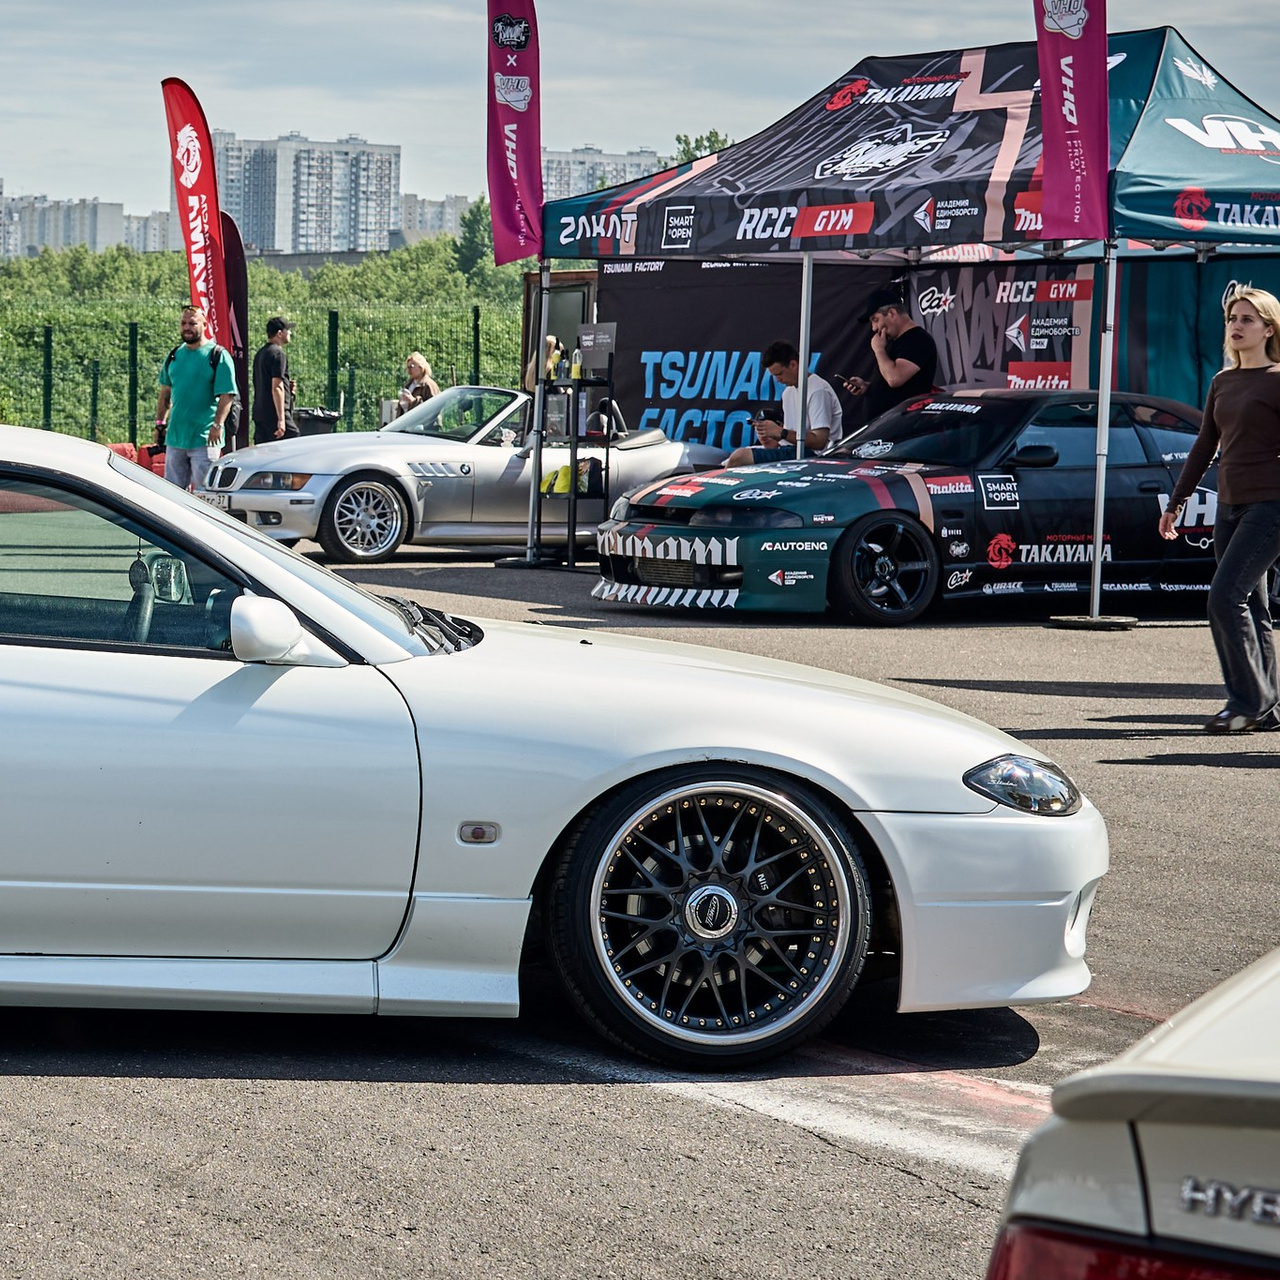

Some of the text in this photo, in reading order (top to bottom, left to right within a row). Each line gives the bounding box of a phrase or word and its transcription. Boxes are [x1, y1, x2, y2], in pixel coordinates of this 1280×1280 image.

[859, 80, 964, 105] TAKAYAMA
[1060, 55, 1078, 126] VHQ
[1072, 140, 1083, 223] PROTECTION
[936, 199, 970, 209] АКАДЕМИЯ
[936, 207, 979, 218] ЕДИНОБОРСТВ
[1214, 202, 1280, 229] TAKA
[668, 215, 695, 227] SMART
[736, 206, 854, 240] RCC GYM
[603, 261, 665, 274] TSUNAMI FACTORY
[995, 281, 1077, 304] RCC GYM
[1031, 318, 1068, 326] АКАДЕМИЯ
[1031, 327, 1081, 337] ЕДИНОБОРСТВ
[1031, 339, 1046, 348] РМК
[638, 408, 760, 454] FACTO
[986, 482, 1018, 492] SMART
[1046, 534, 1086, 542] МОТОРНЫЕ
[773, 541, 828, 551] AUTOENG
